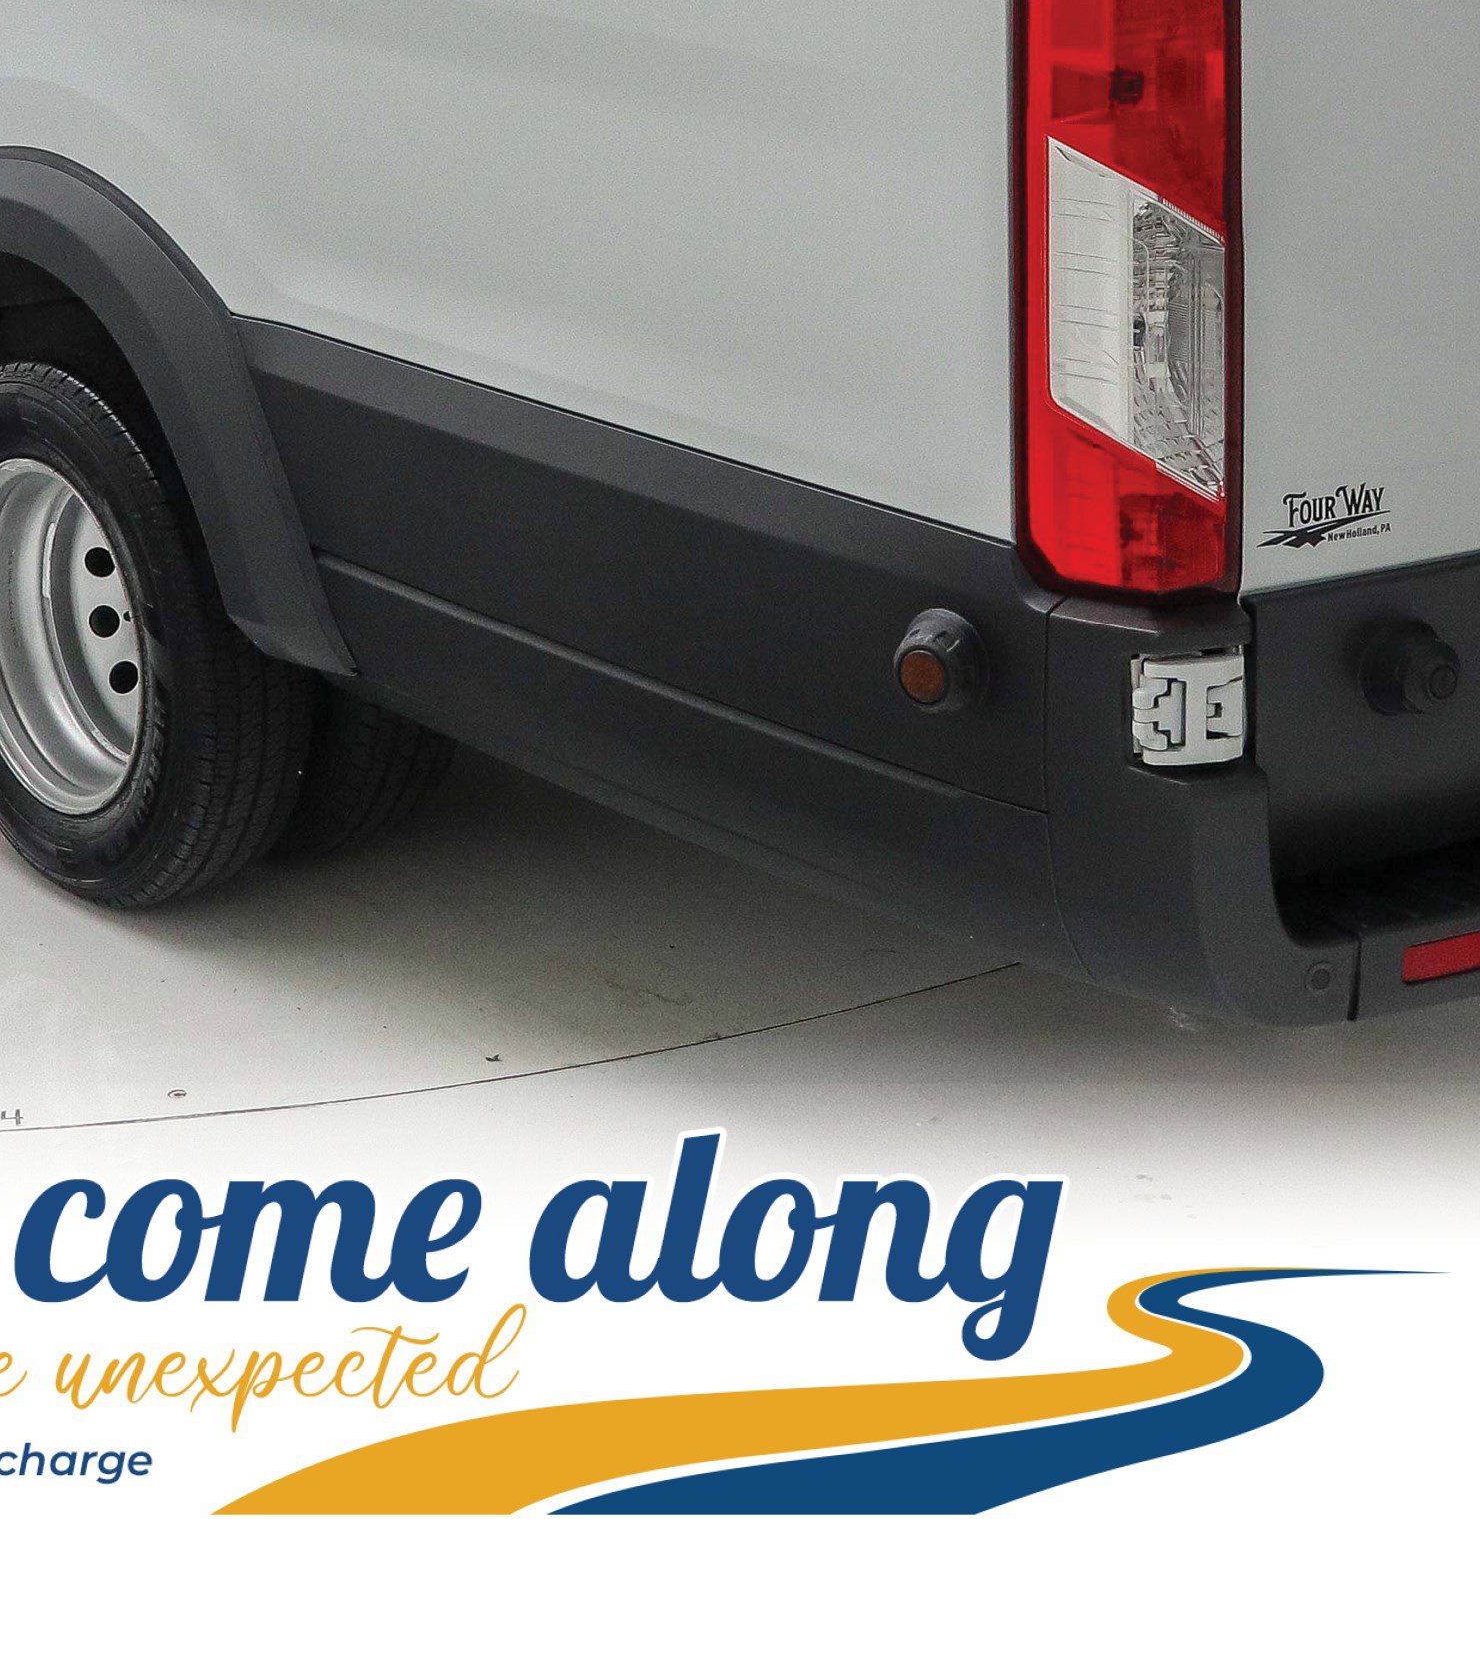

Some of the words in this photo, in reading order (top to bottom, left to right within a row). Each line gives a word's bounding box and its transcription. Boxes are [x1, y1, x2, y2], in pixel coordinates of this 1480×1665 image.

[1283, 491, 1336, 527] FOUR
[1335, 482, 1385, 515] WAY
[1327, 532, 1345, 542] New
[1380, 523, 1391, 533] PA
